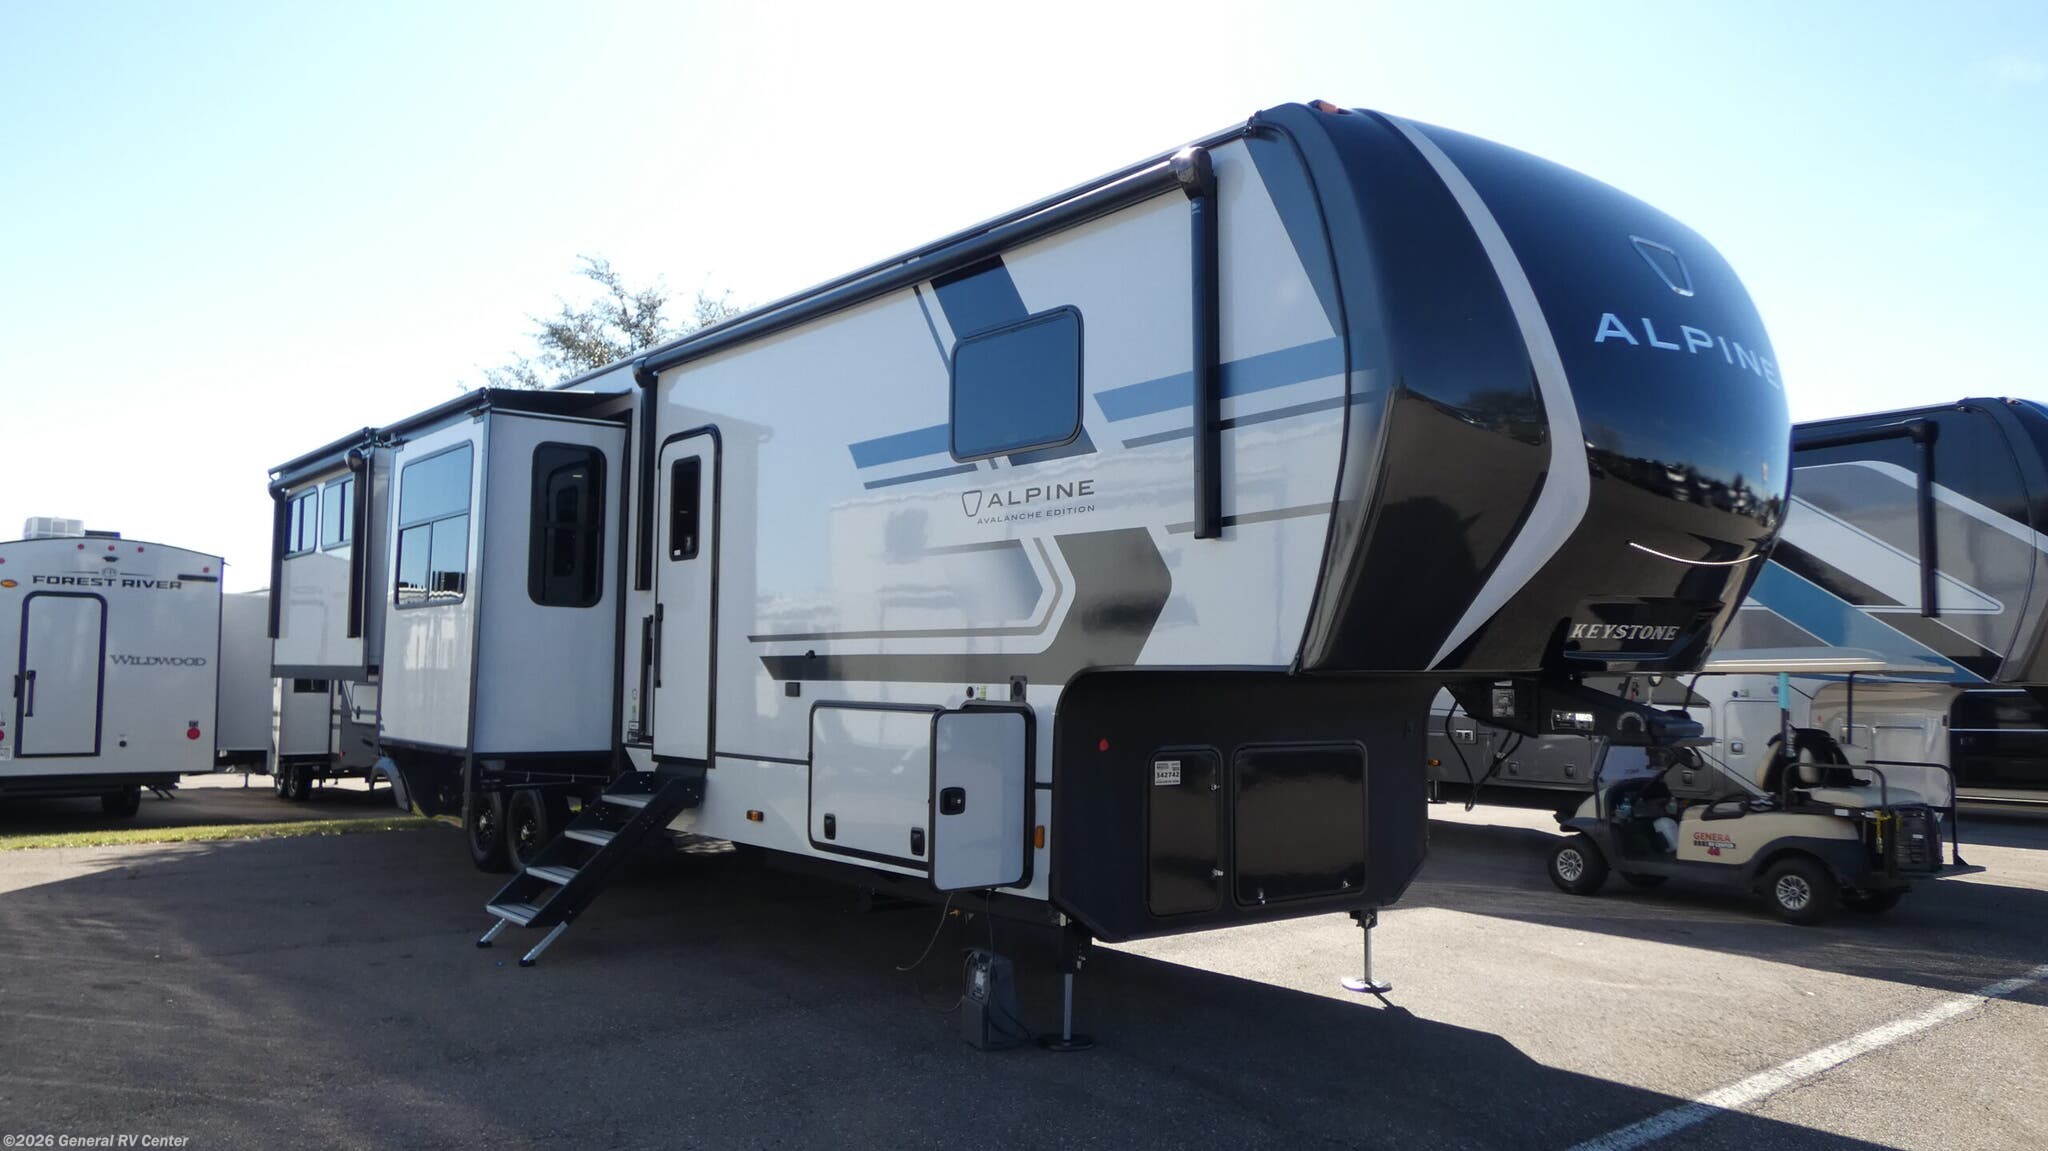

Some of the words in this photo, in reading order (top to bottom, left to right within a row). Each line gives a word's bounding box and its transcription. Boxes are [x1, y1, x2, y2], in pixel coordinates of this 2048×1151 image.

[1594, 312, 1781, 390] ALPINE
[987, 479, 1095, 508] ALPINE
[977, 511, 1042, 524] AVALANCHE
[1046, 505, 1095, 517] EDITION
[32, 575, 116, 587] FOREST
[121, 580, 182, 590] RIVER
[1570, 623, 1681, 640] KEYSTONE
[110, 654, 207, 666] WILDWOOD
